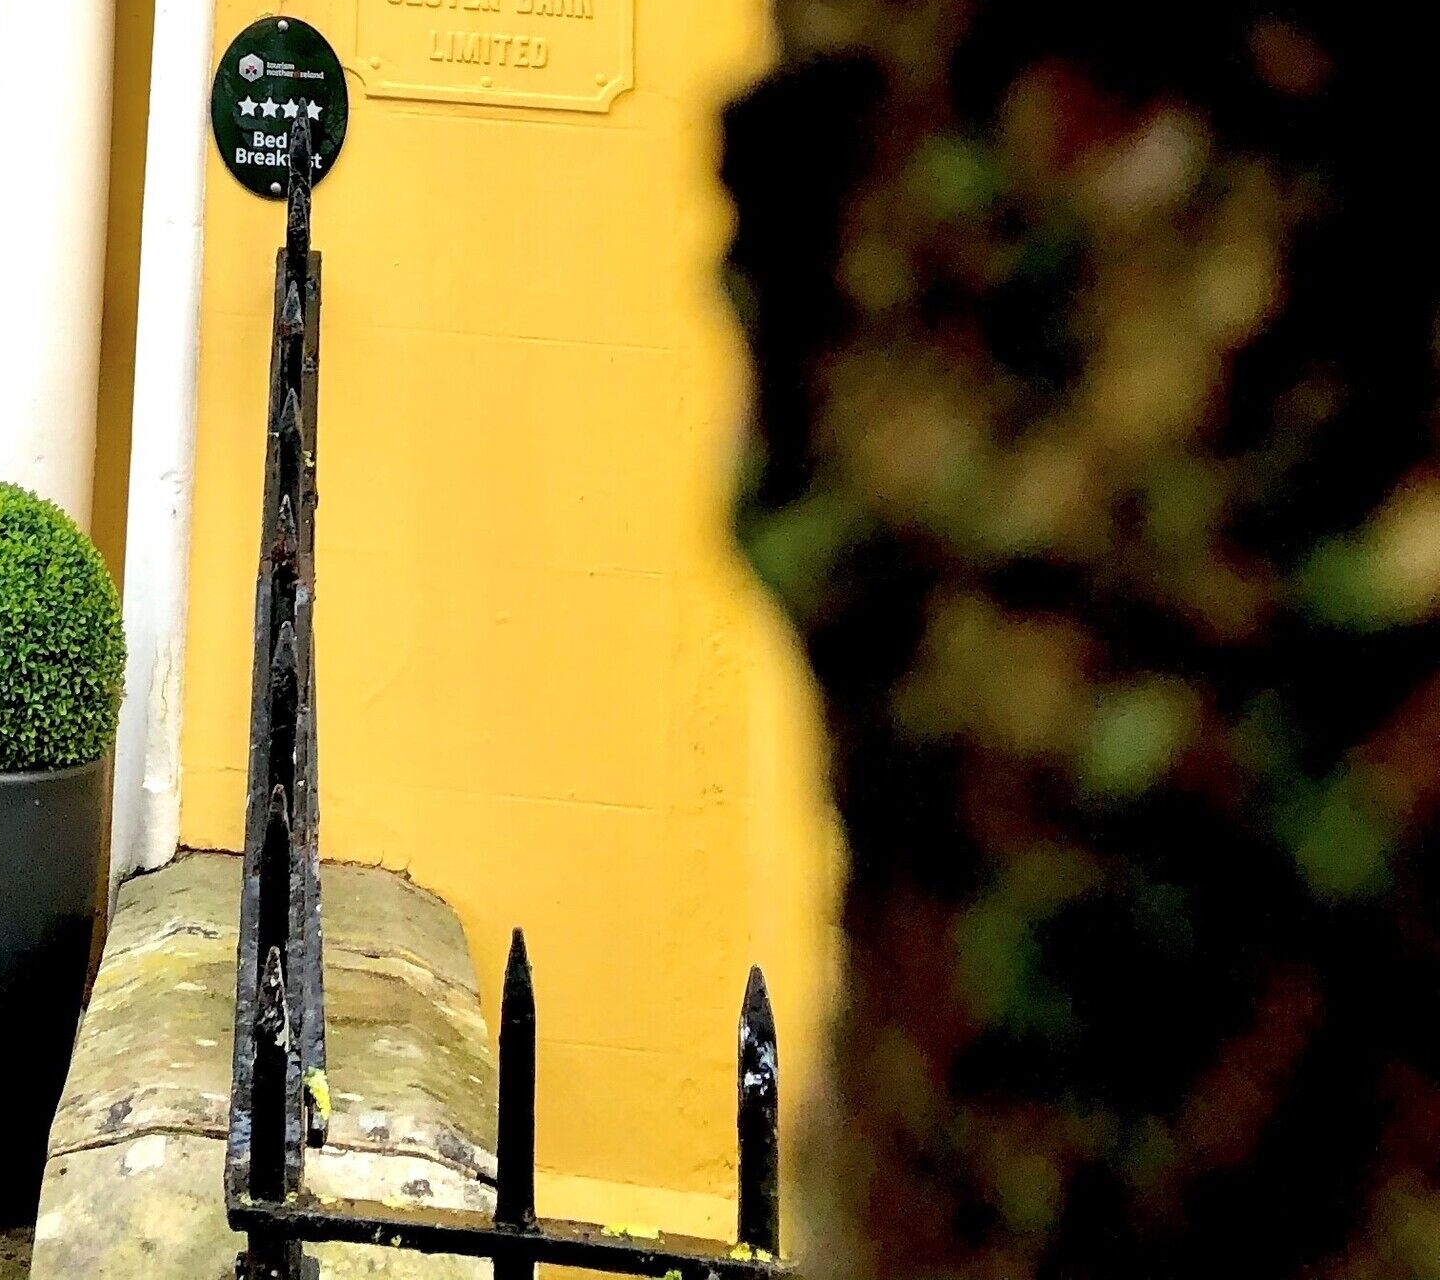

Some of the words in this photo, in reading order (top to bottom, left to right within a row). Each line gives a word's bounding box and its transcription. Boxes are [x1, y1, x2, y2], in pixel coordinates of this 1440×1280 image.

[429, 29, 549, 70] LIMITED
[253, 130, 288, 149] Bed
[235, 147, 323, 169] Breakt
